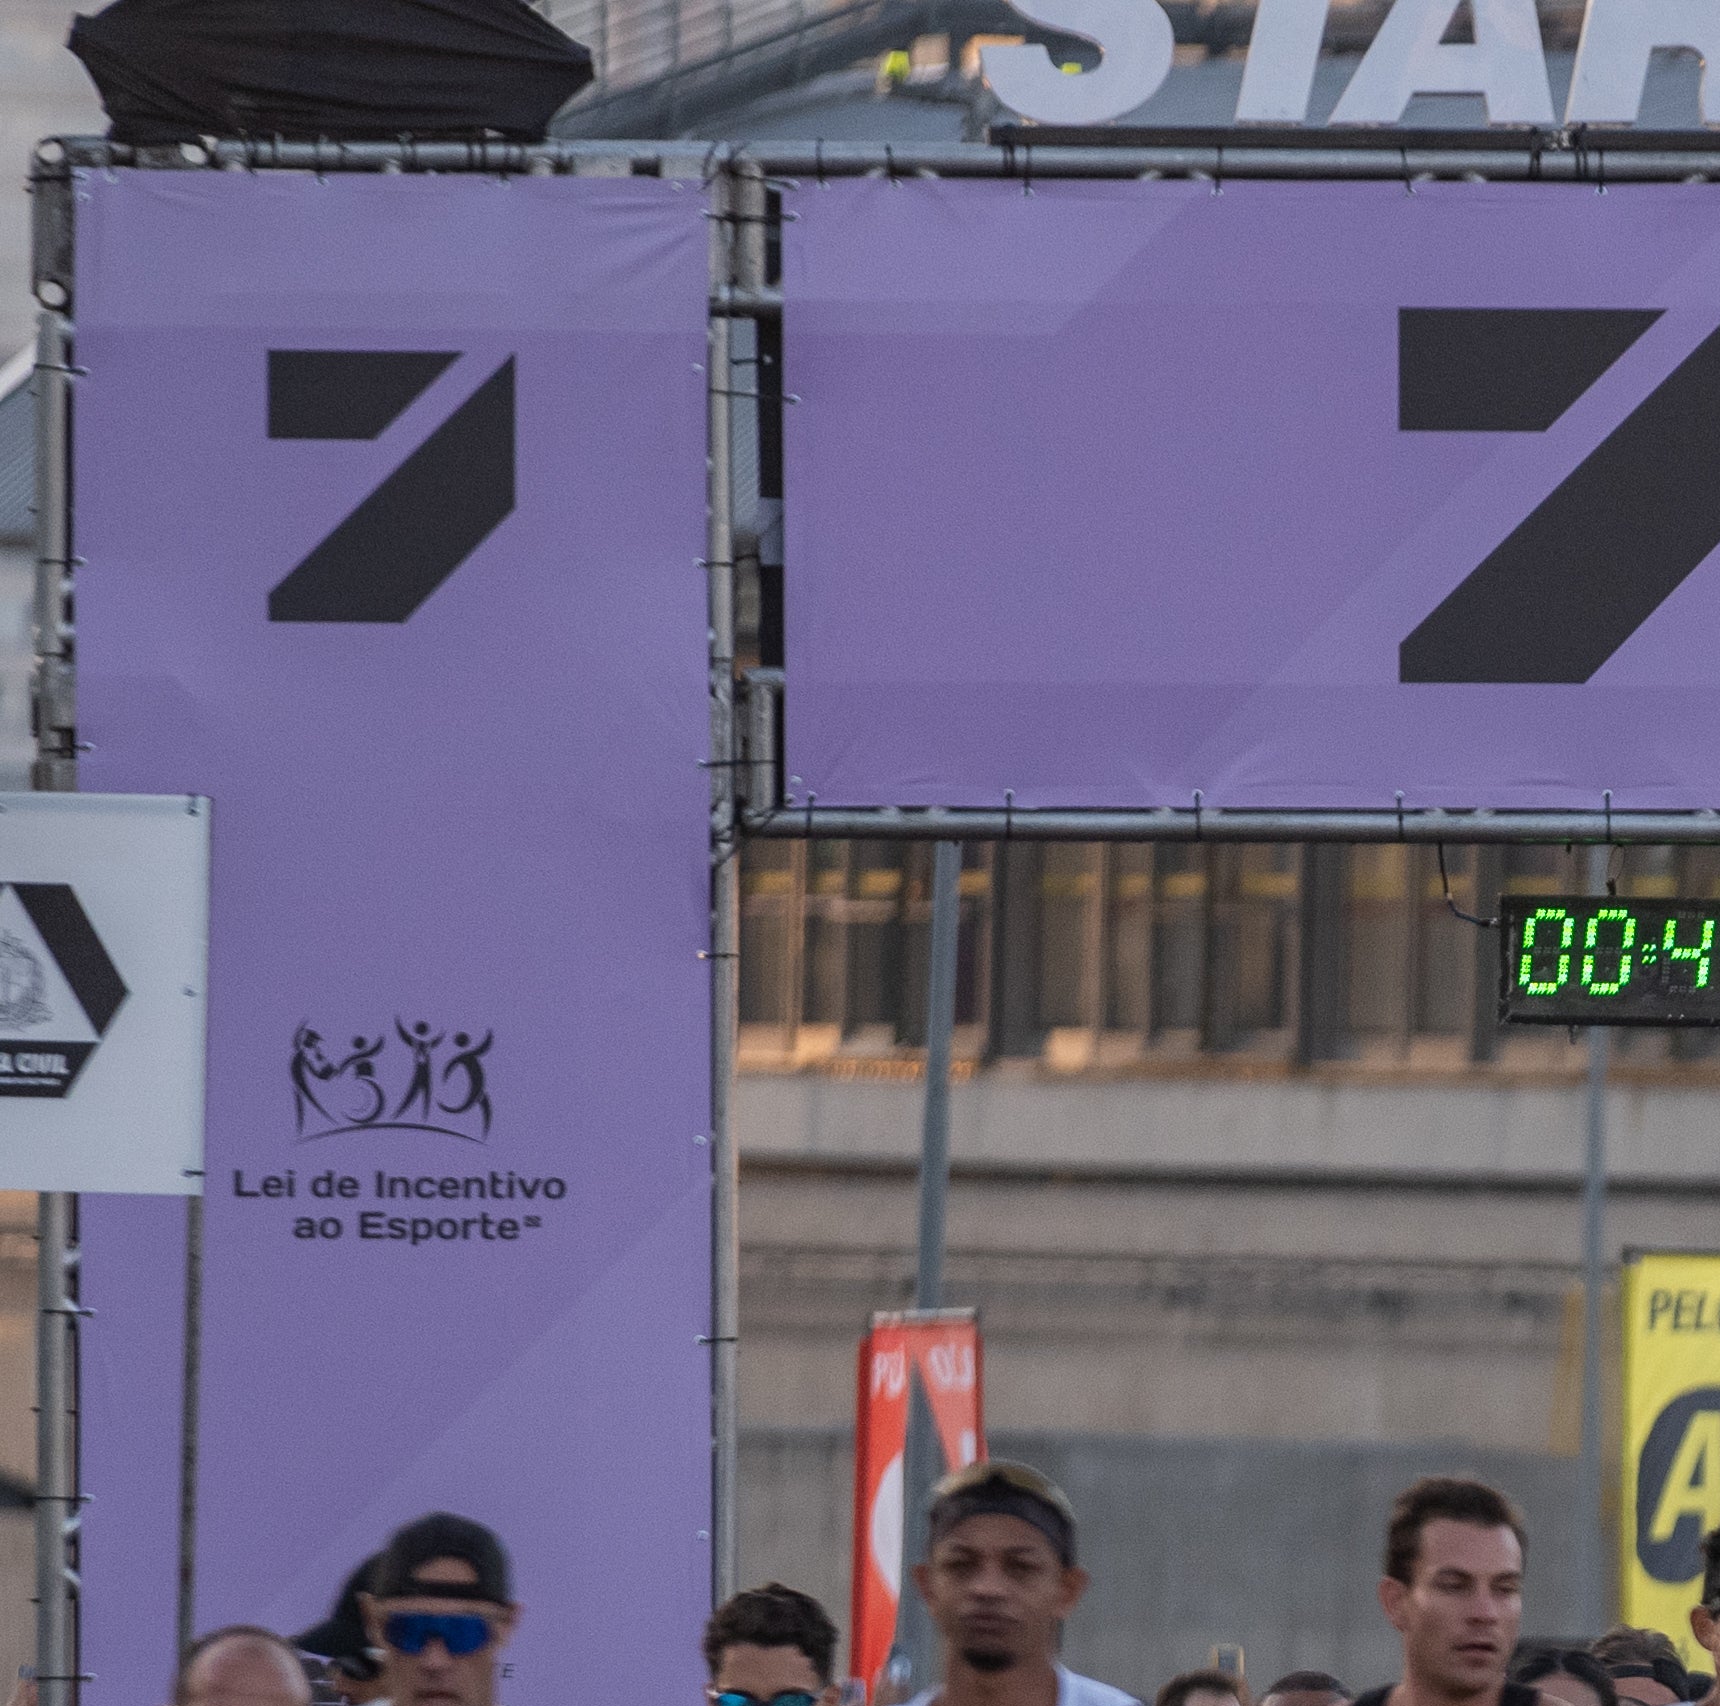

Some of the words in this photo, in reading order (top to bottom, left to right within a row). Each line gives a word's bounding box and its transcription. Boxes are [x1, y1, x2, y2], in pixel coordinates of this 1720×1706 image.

[232, 1169, 297, 1199] Lei
[309, 1169, 361, 1199] de
[374, 1169, 567, 1200] Incentivo
[293, 1215, 344, 1240] ao
[358, 1210, 521, 1246] Esporte
